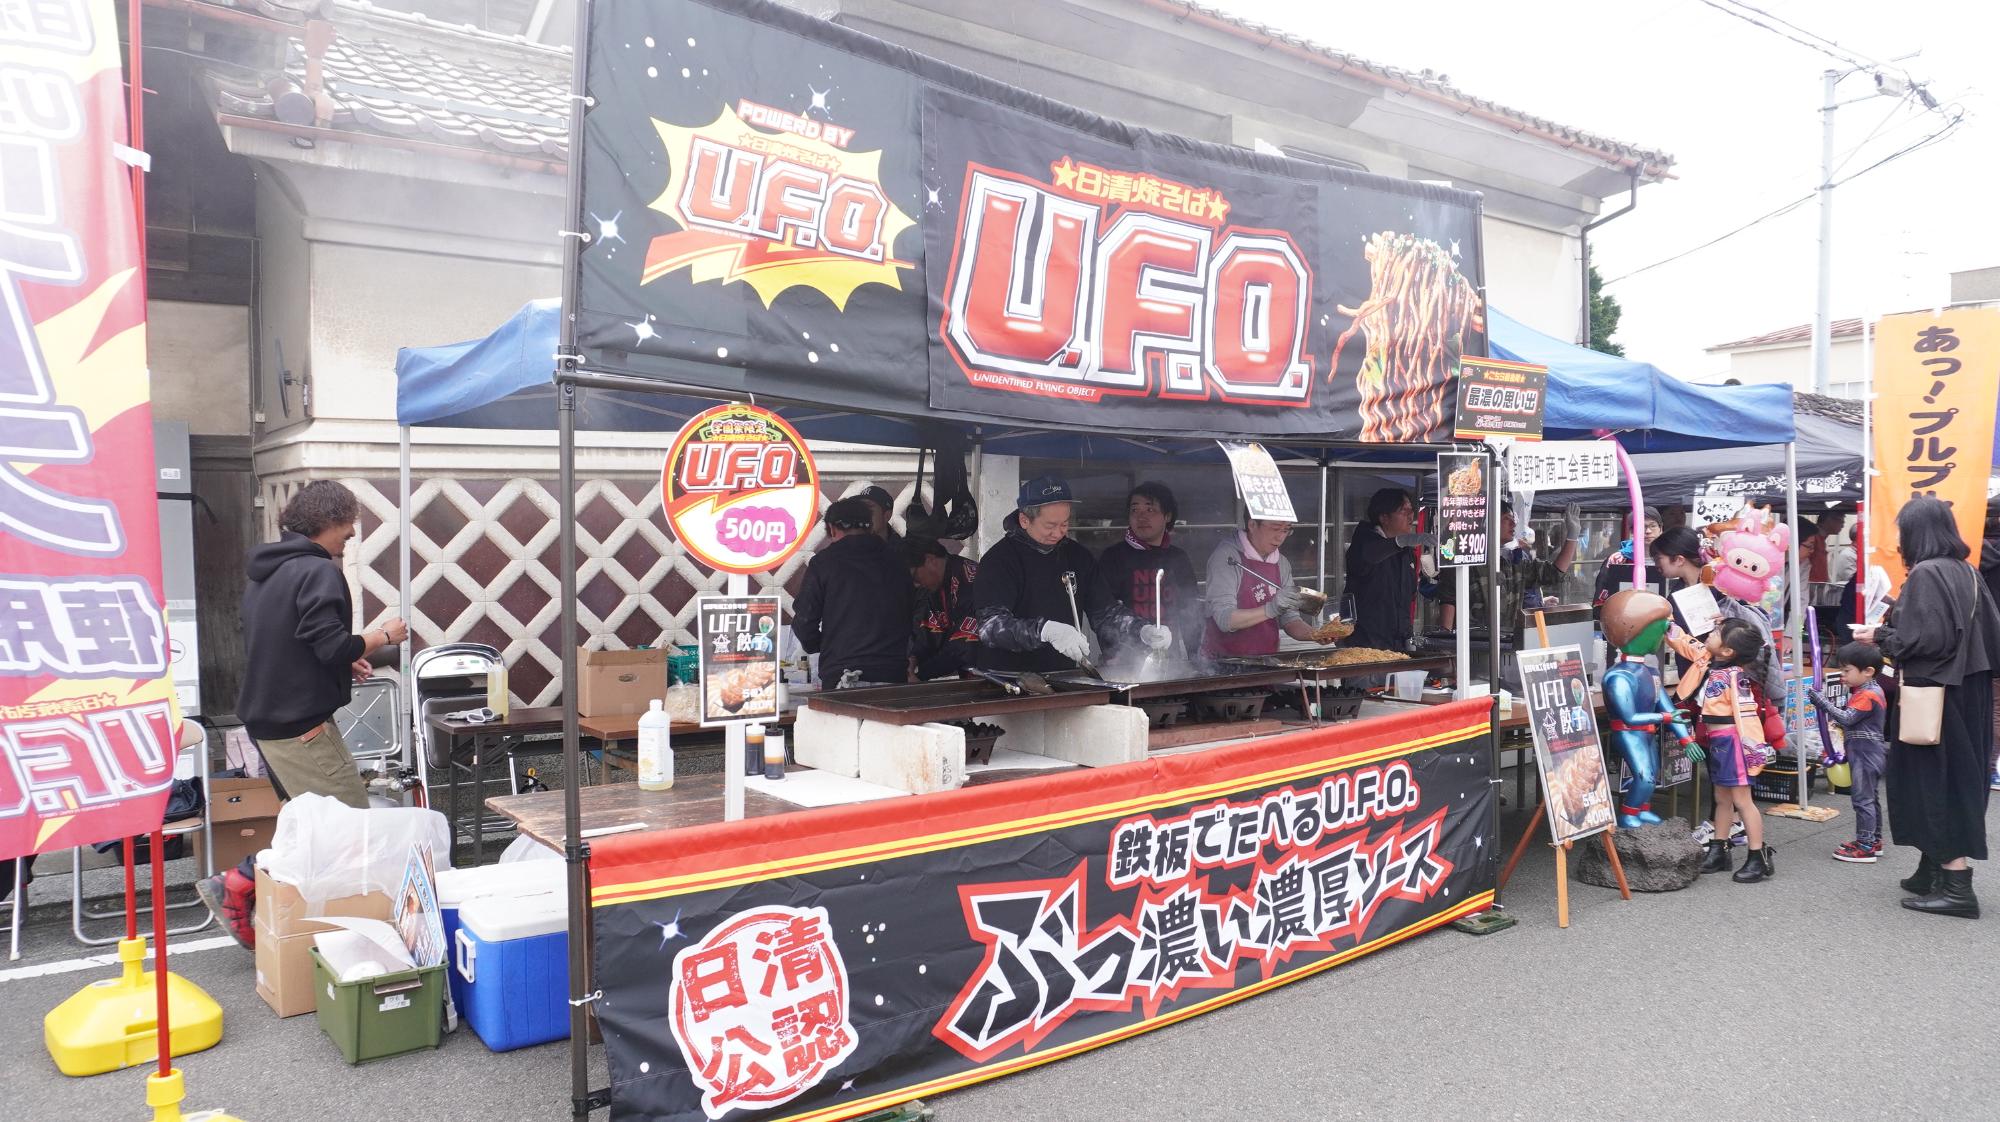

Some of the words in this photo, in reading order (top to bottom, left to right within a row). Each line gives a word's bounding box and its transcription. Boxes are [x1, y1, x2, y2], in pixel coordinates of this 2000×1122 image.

[737, 101, 820, 139] POWERD
[822, 124, 852, 146] BY
[680, 139, 889, 262] U.F.O.
[1074, 164, 1207, 216] 日清焼そば
[948, 171, 1312, 399] U.F.O.
[973, 373, 1033, 389] UNIDENTIFIED
[1035, 381, 1065, 393] FLYING
[1066, 386, 1096, 396] OBJECT
[1467, 386, 1537, 411] 最濃の思い出
[680, 442, 797, 492] U.F.O.
[1241, 474, 1283, 494] 焼きそば
[1512, 452, 1615, 485] 飯野町商工会青年部
[725, 517, 785, 543] 500円
[1442, 509, 1486, 518] UFOやきそば
[1458, 533, 1486, 554] ¥900
[709, 613, 752, 633] UFO
[1531, 678, 1567, 711] UFO
[1114, 768, 1418, 878] 鉄板でたべるU.F.O.
[952, 822, 1444, 1048] ぶっ濃い濃厚ソース
[681, 915, 827, 1023] 日清
[703, 988, 851, 1108] 公認
